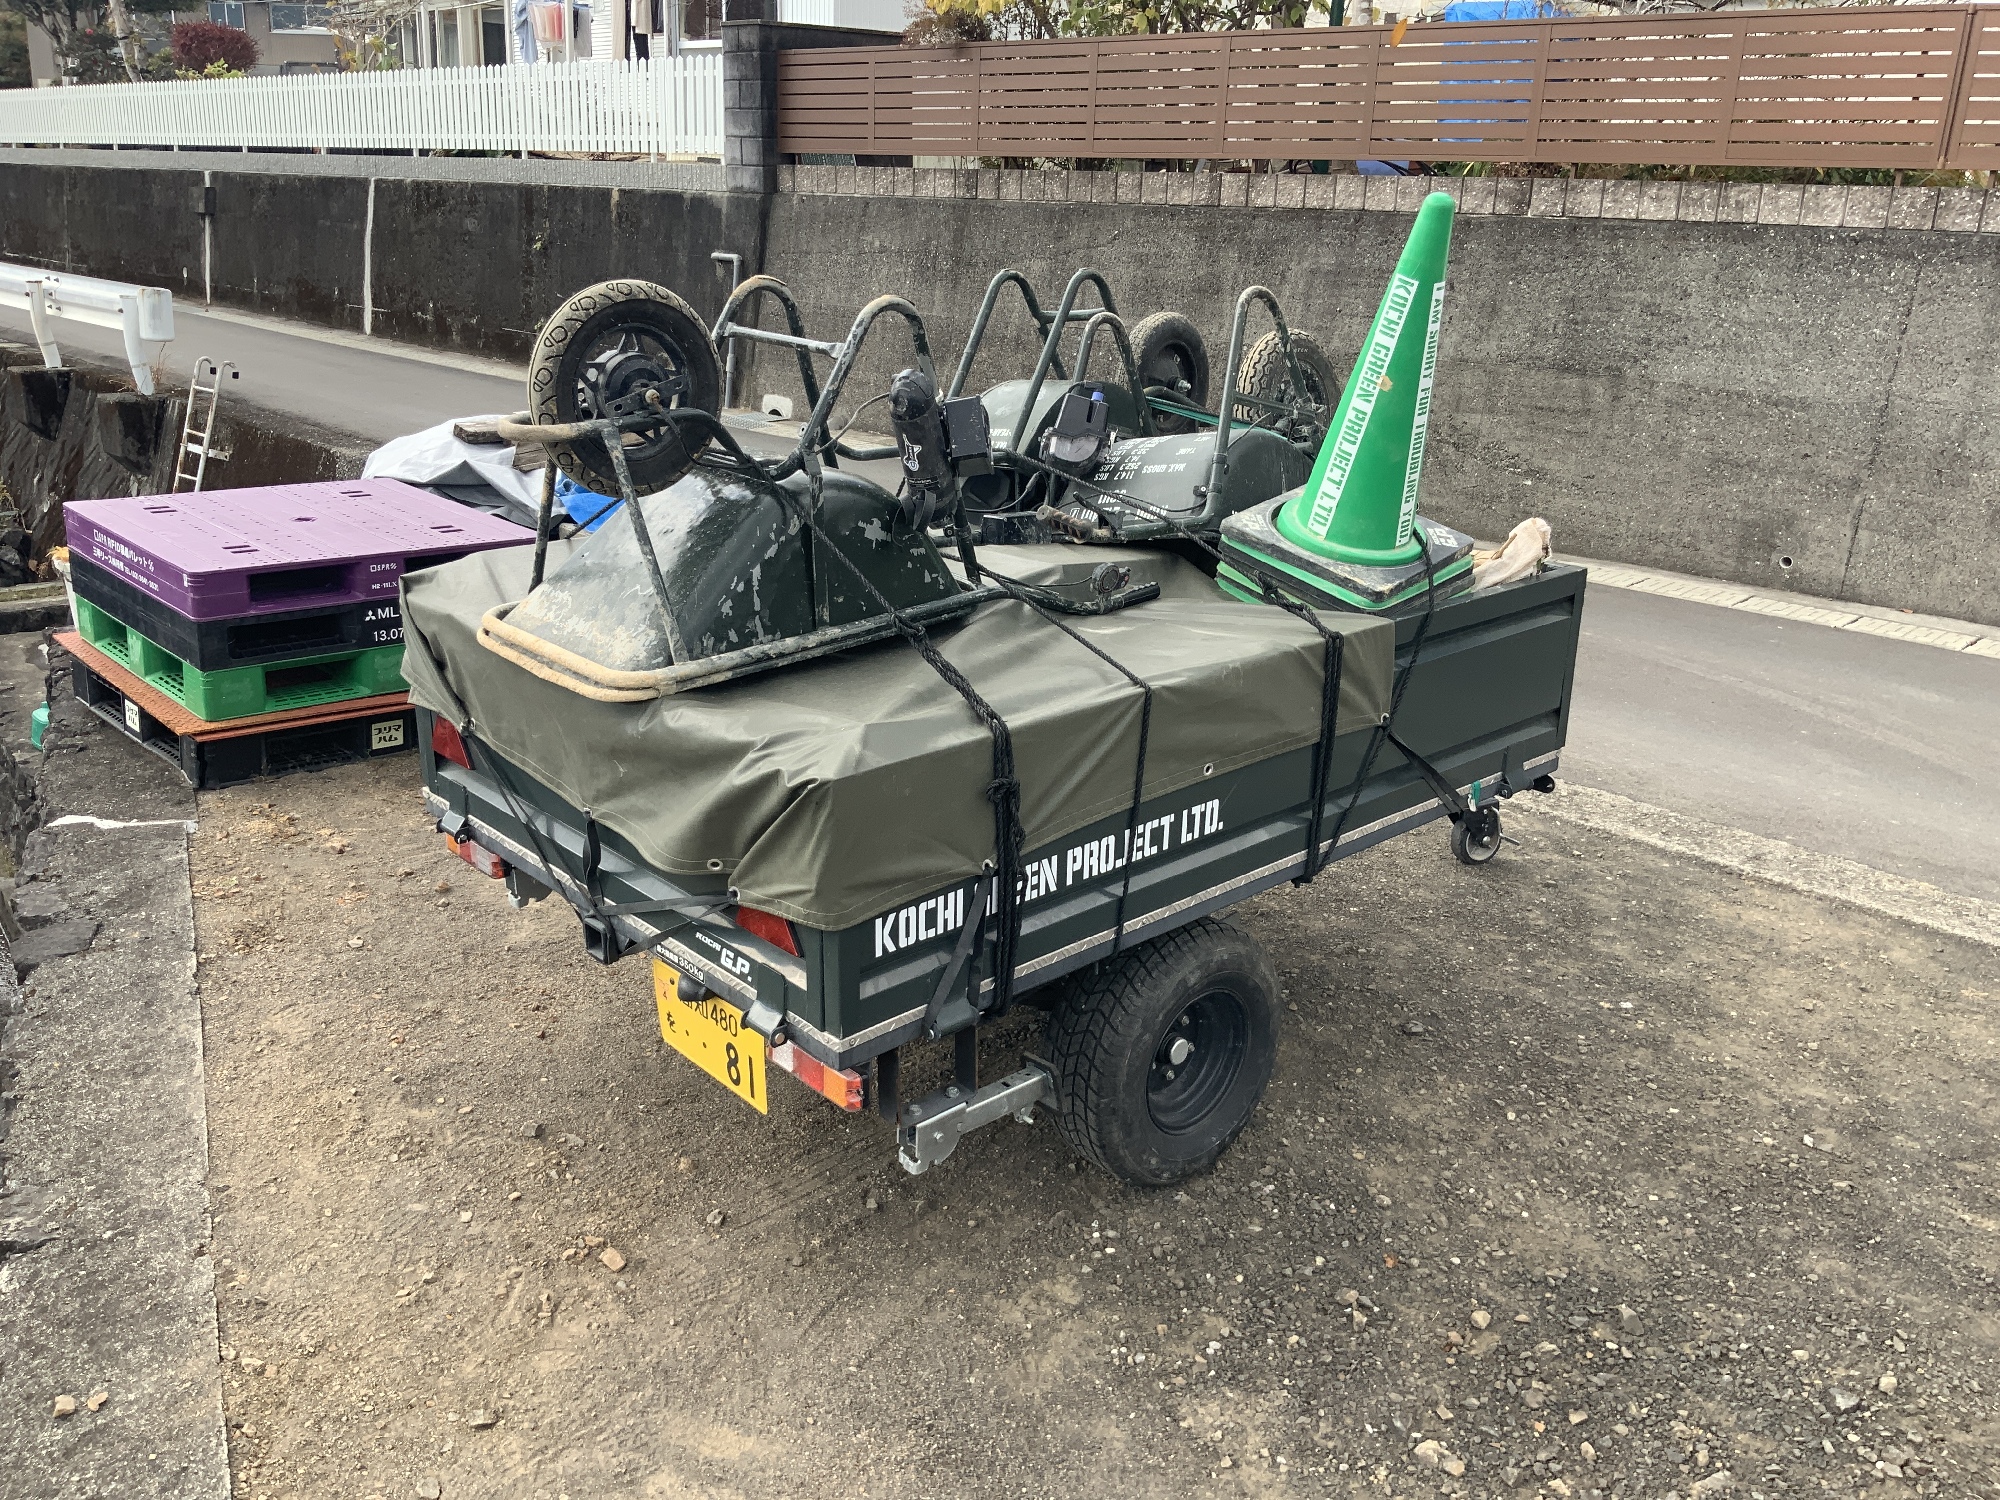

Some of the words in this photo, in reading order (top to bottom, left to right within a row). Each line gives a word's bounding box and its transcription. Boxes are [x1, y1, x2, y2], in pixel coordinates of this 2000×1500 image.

[1378, 277, 1415, 339] KOCHI
[1431, 298, 1442, 325] AM
[1355, 341, 1391, 404] GREEN
[1417, 386, 1430, 417] FOR
[1327, 406, 1368, 490] PROJECT
[1403, 420, 1425, 505] TROUBLING
[1310, 491, 1337, 528] LTD.
[874, 888, 964, 958] KOCHI
[1066, 813, 1175, 886] PROJECT
[1181, 798, 1224, 845] LTD.
[710, 1011, 738, 1037] 480
